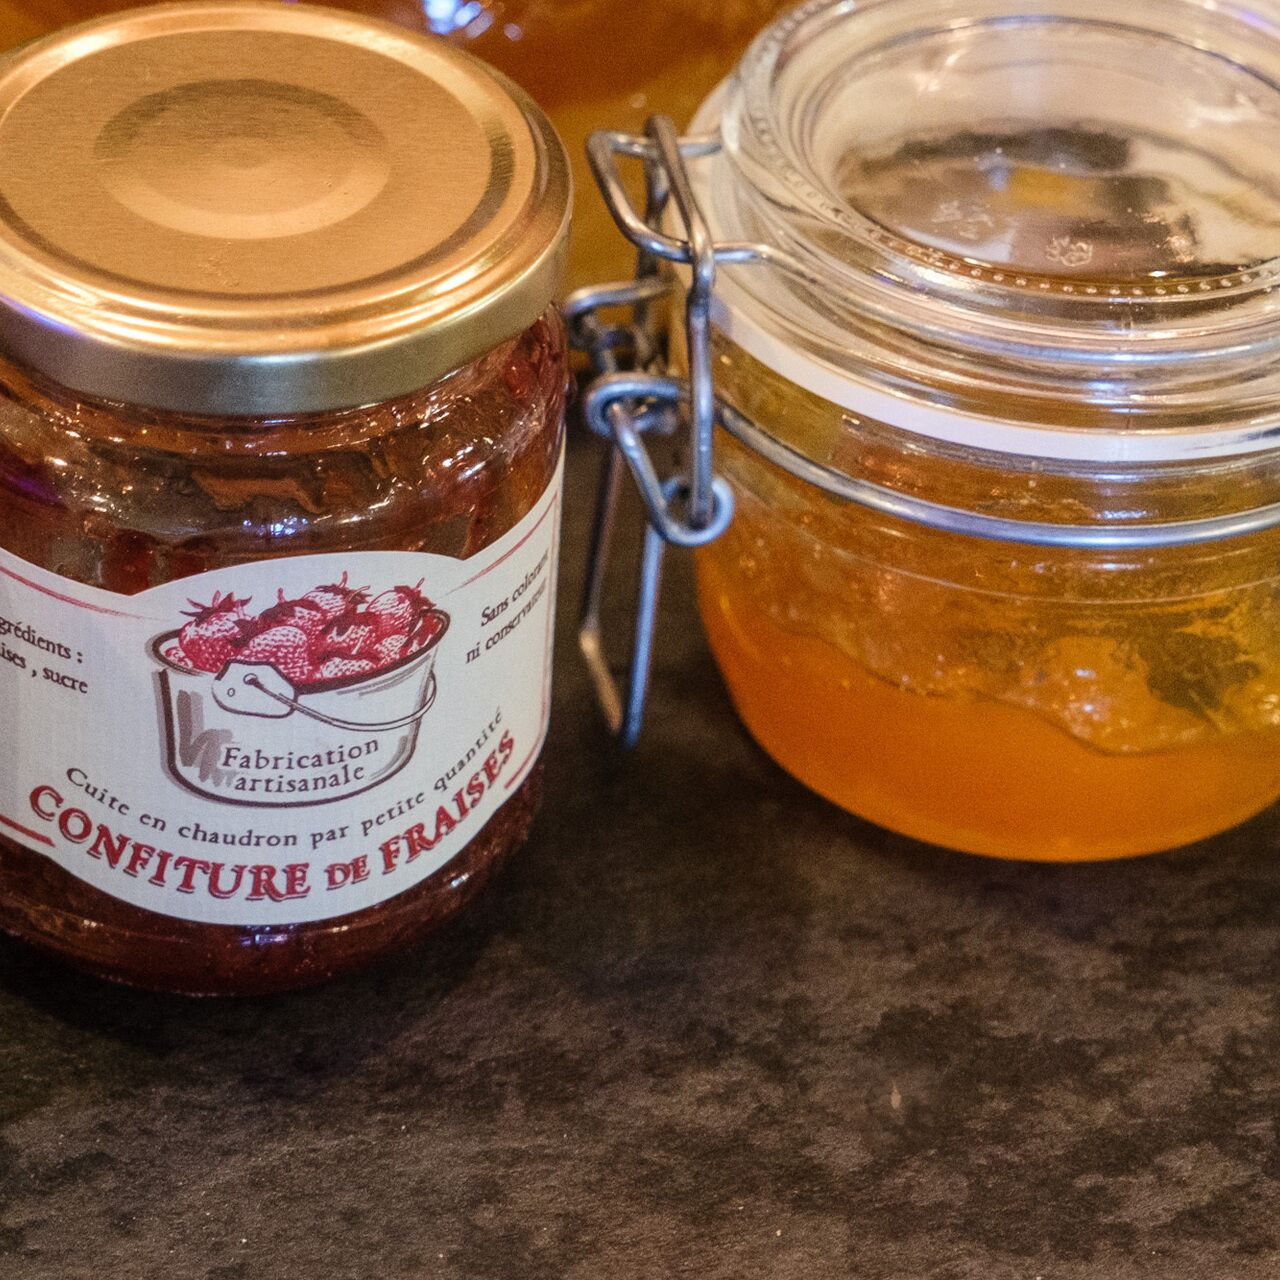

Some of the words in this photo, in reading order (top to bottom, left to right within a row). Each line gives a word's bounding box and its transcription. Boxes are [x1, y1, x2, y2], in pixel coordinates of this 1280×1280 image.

[481, 597, 509, 627] Sans
[466, 641, 480, 664] ni
[43, 667, 88, 694] sucre
[222, 739, 379, 770] Fabrication
[66, 767, 130, 816] Cuite
[139, 813, 167, 832] en
[178, 823, 297, 847] chaudron
[311, 825, 350, 850] par
[361, 791, 425, 837] petite
[433, 705, 503, 792] quantité
[235, 764, 365, 793] artisanale
[29, 784, 311, 903] CONFITURE
[325, 854, 371, 891] DE
[379, 729, 515, 876] FRAISES
